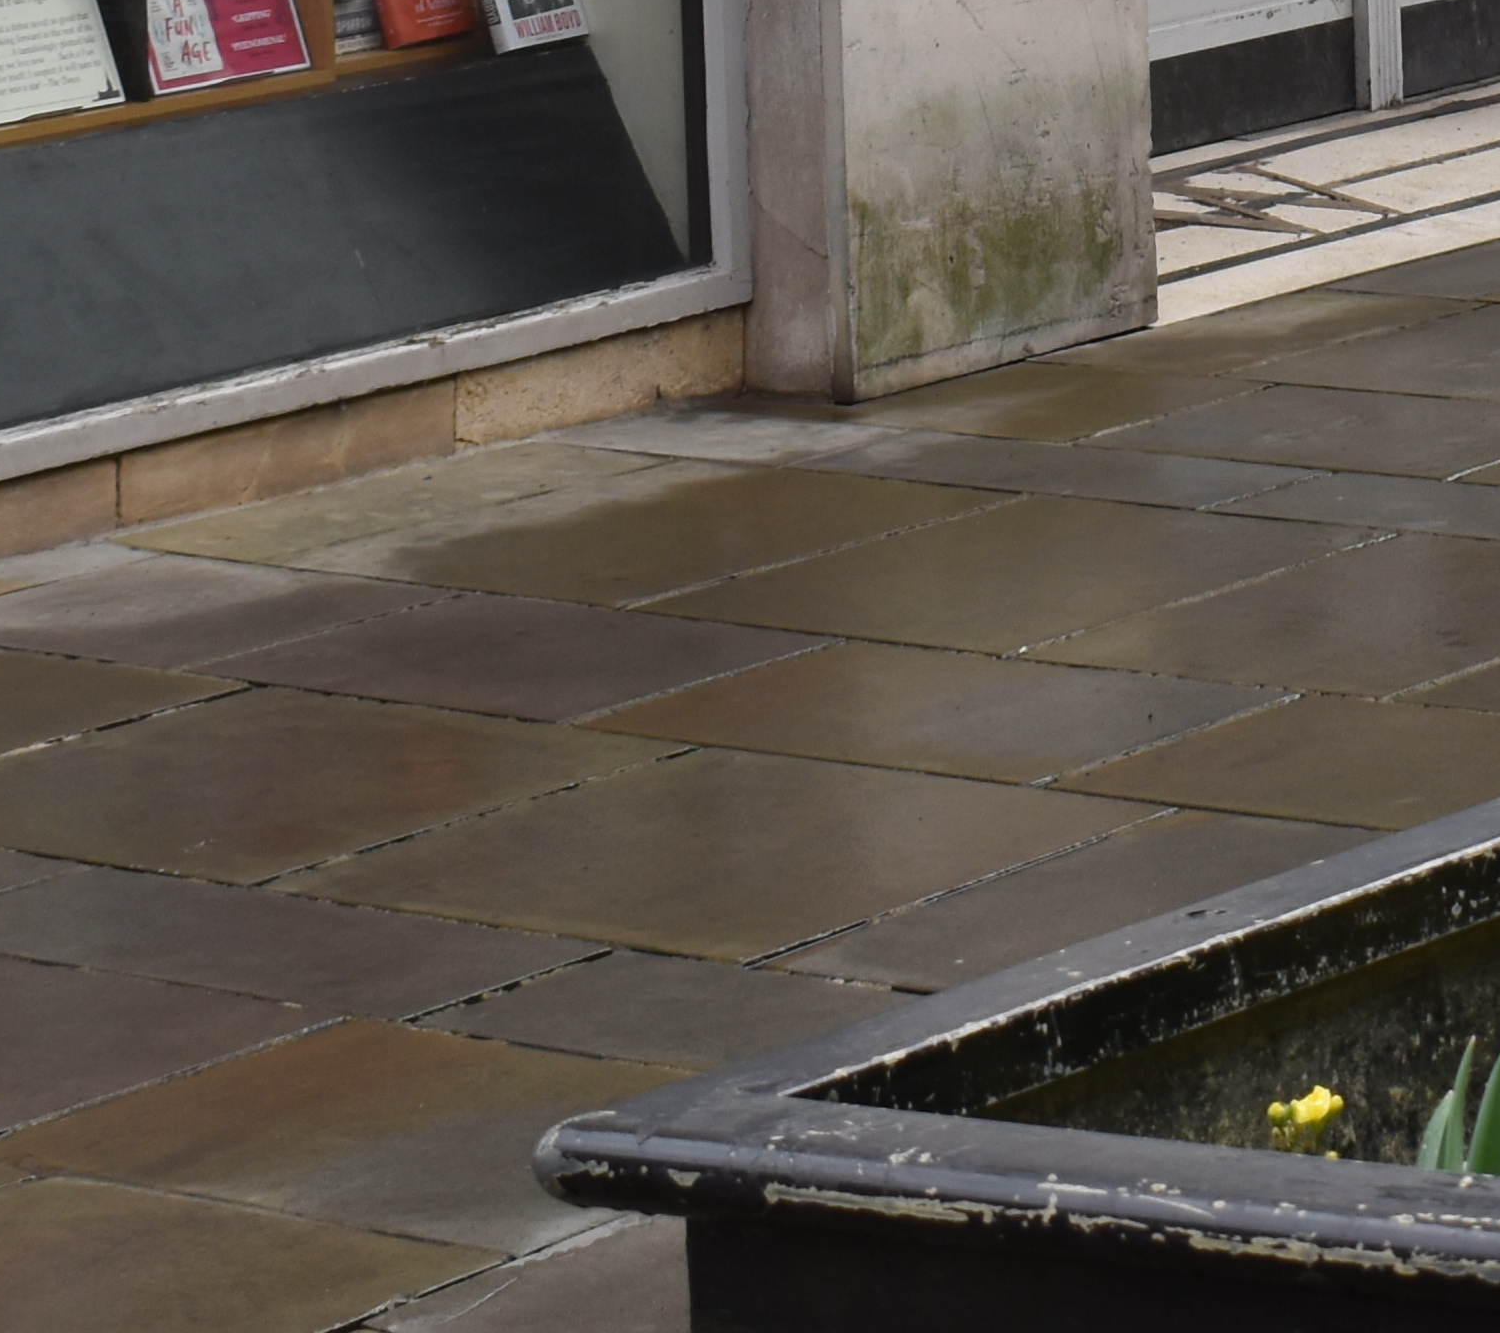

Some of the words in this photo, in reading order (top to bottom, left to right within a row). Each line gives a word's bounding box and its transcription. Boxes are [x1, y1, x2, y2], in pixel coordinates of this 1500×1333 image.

[513, 16, 555, 39] WILLIAM
[553, 8, 582, 32] BOYD
[180, 39, 212, 67] AGE
